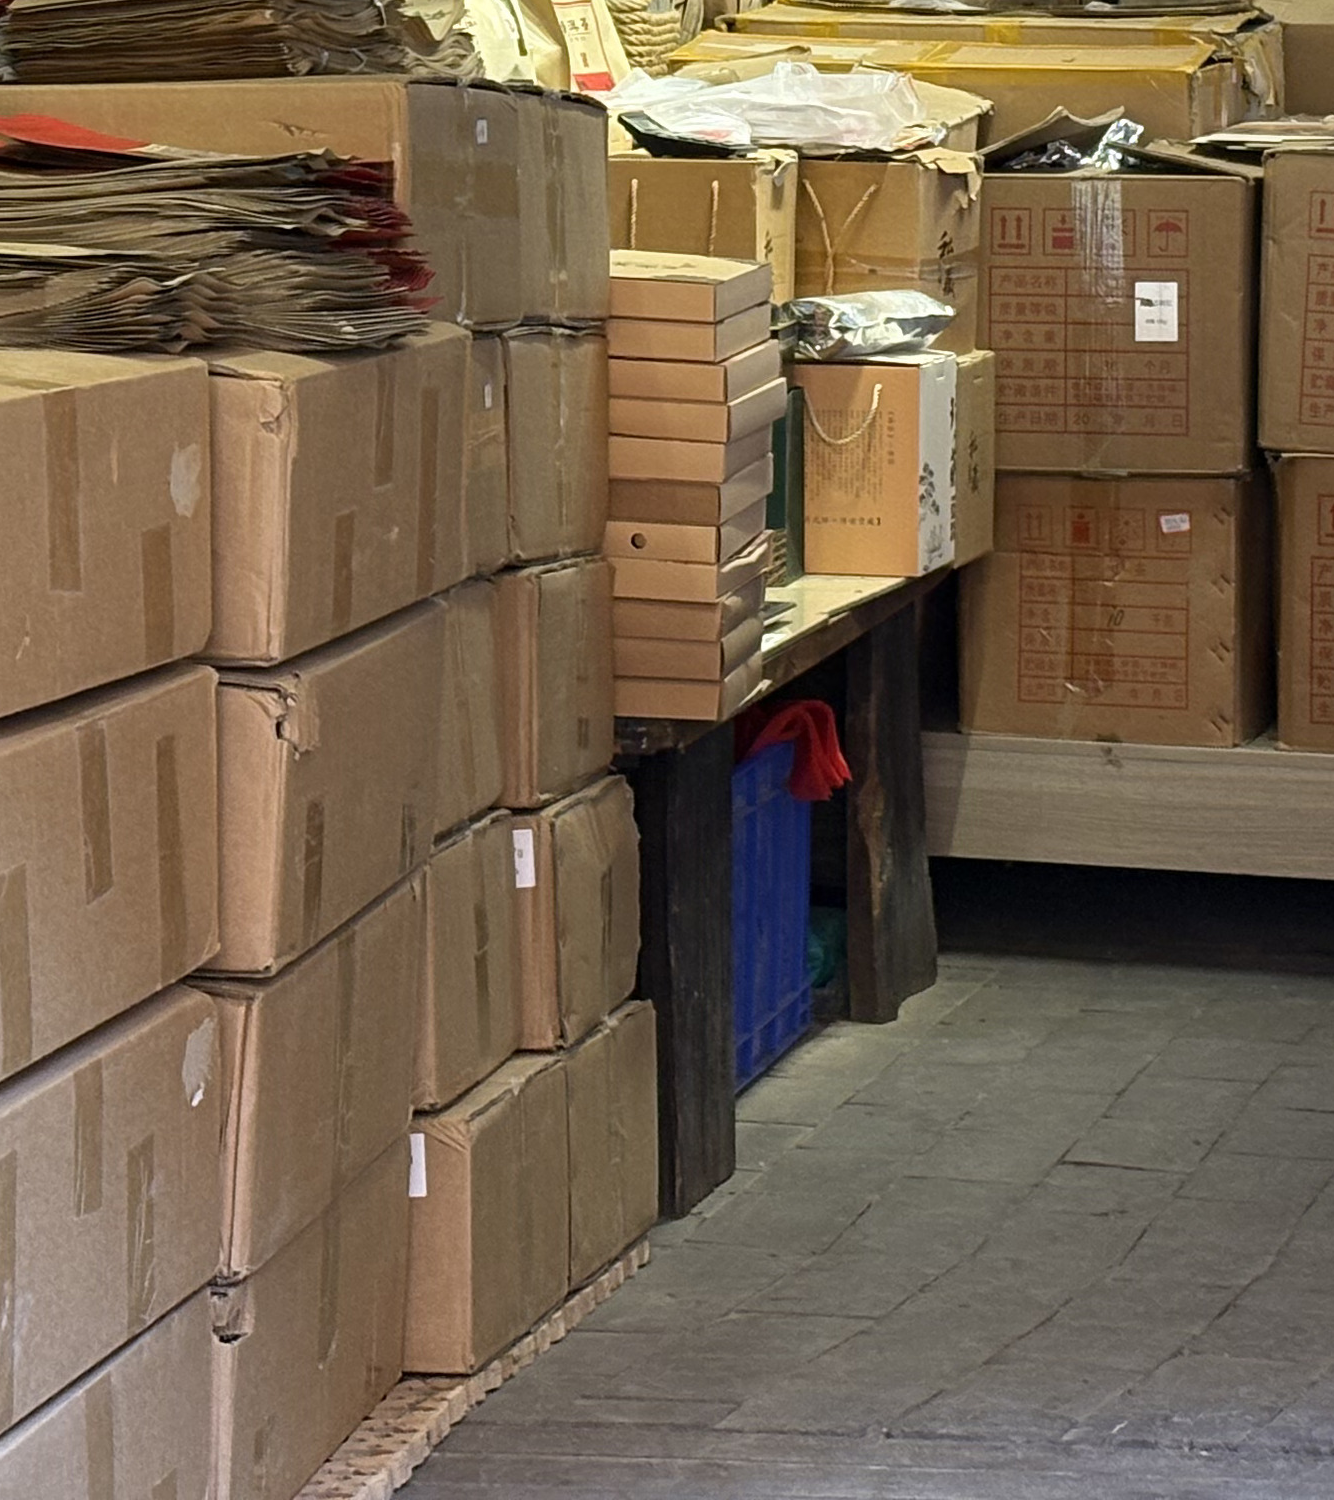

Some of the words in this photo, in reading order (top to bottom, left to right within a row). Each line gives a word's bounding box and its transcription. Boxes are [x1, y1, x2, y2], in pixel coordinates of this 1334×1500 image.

[998, 273, 1058, 289] 产品名称
[1001, 328, 1057, 345] 净含量
[998, 412, 1059, 427] 生产日期
[1072, 413, 1091, 427] 20
[1172, 414, 1184, 428] 日
